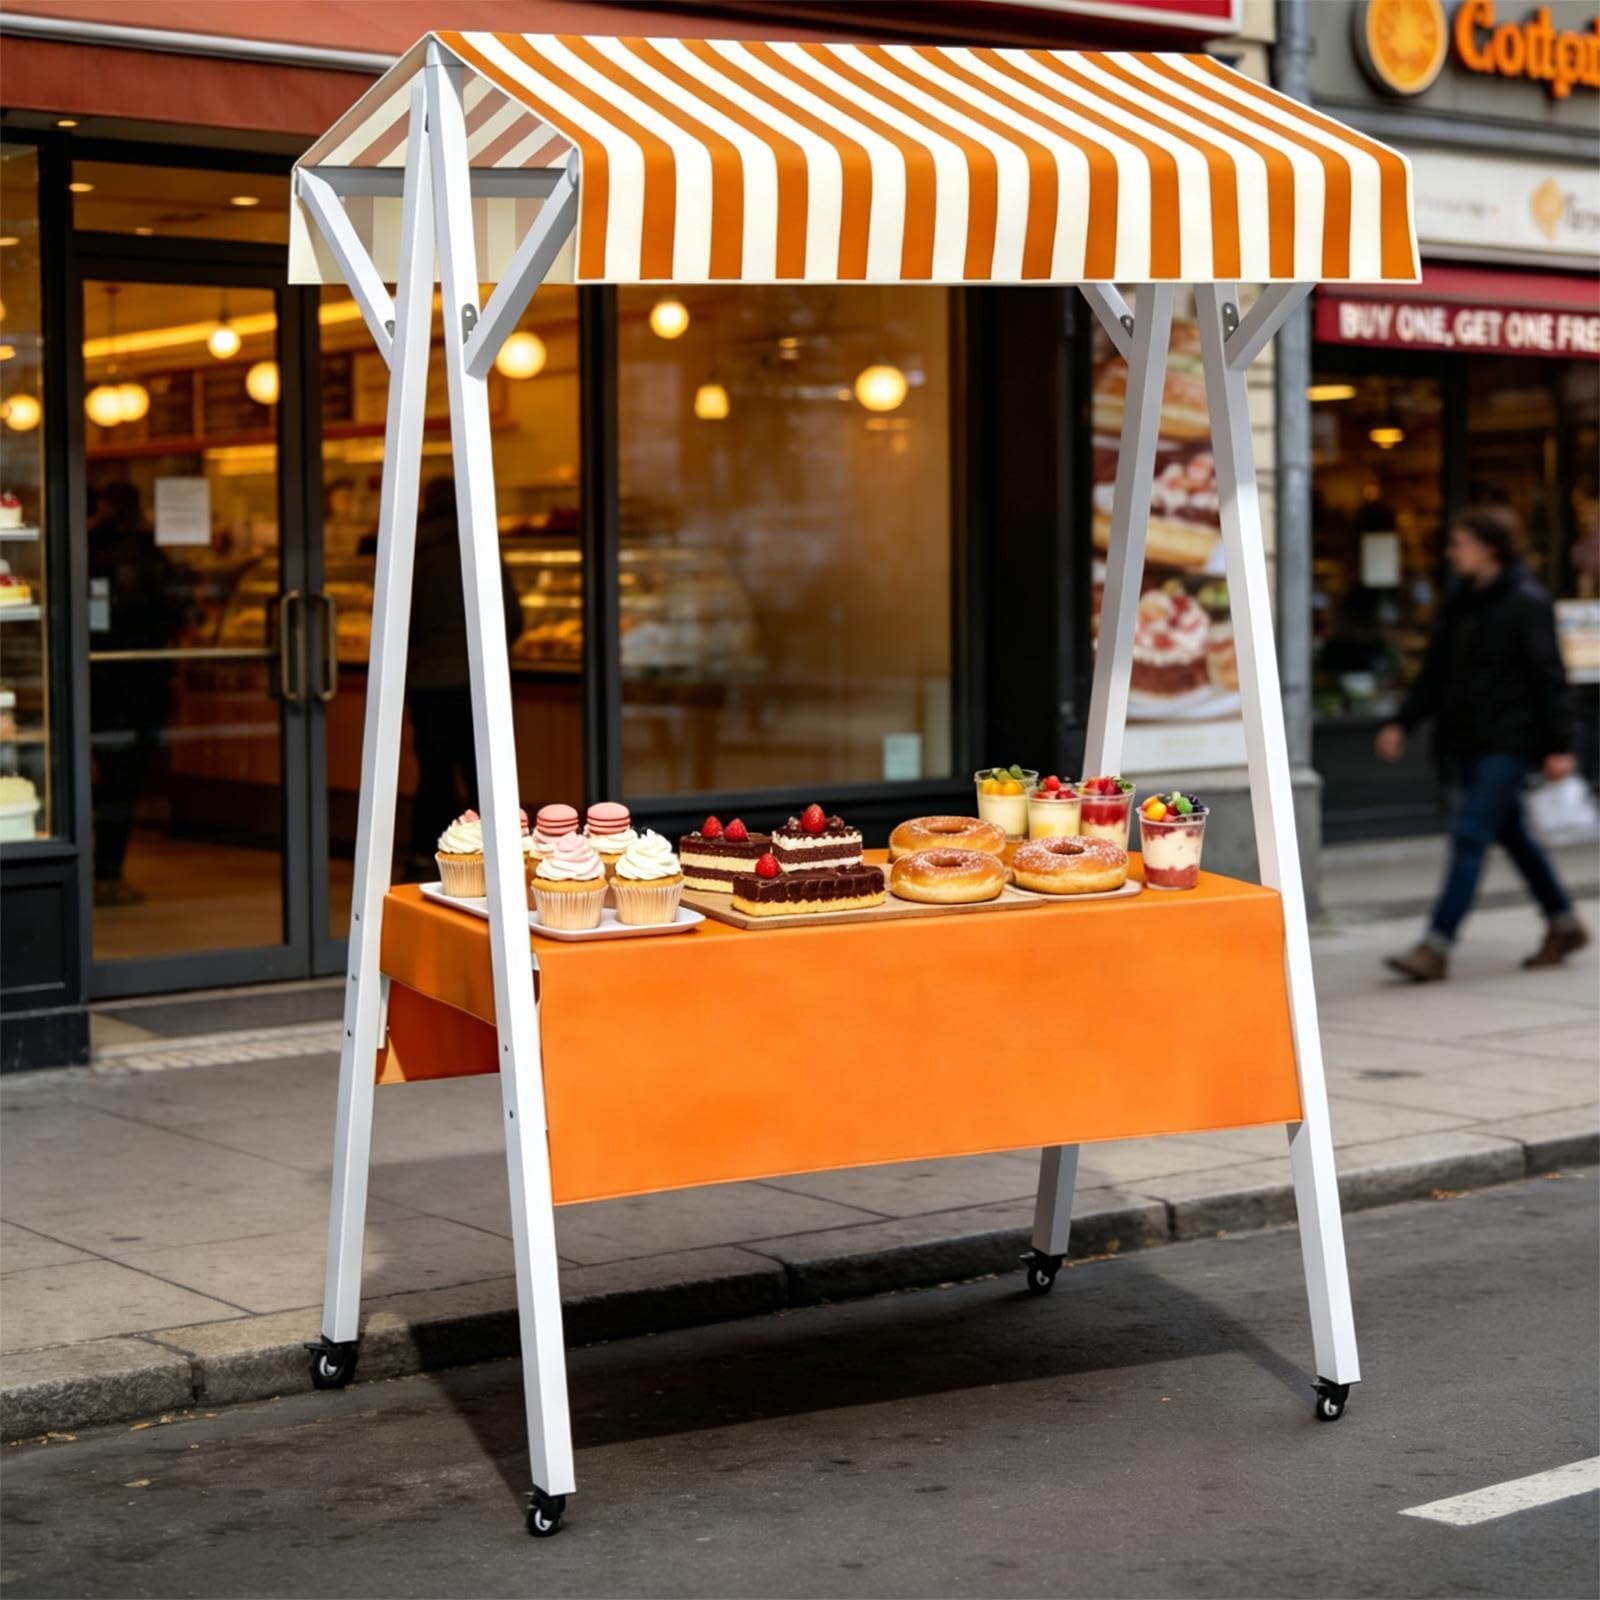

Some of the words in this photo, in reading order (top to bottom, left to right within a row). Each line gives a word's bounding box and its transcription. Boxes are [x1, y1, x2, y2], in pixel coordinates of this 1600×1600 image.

[1339, 302, 1394, 339] BUY
[1396, 305, 1455, 347] ONE,
[1455, 309, 1502, 346] GET
[1504, 311, 1554, 351] ONE
